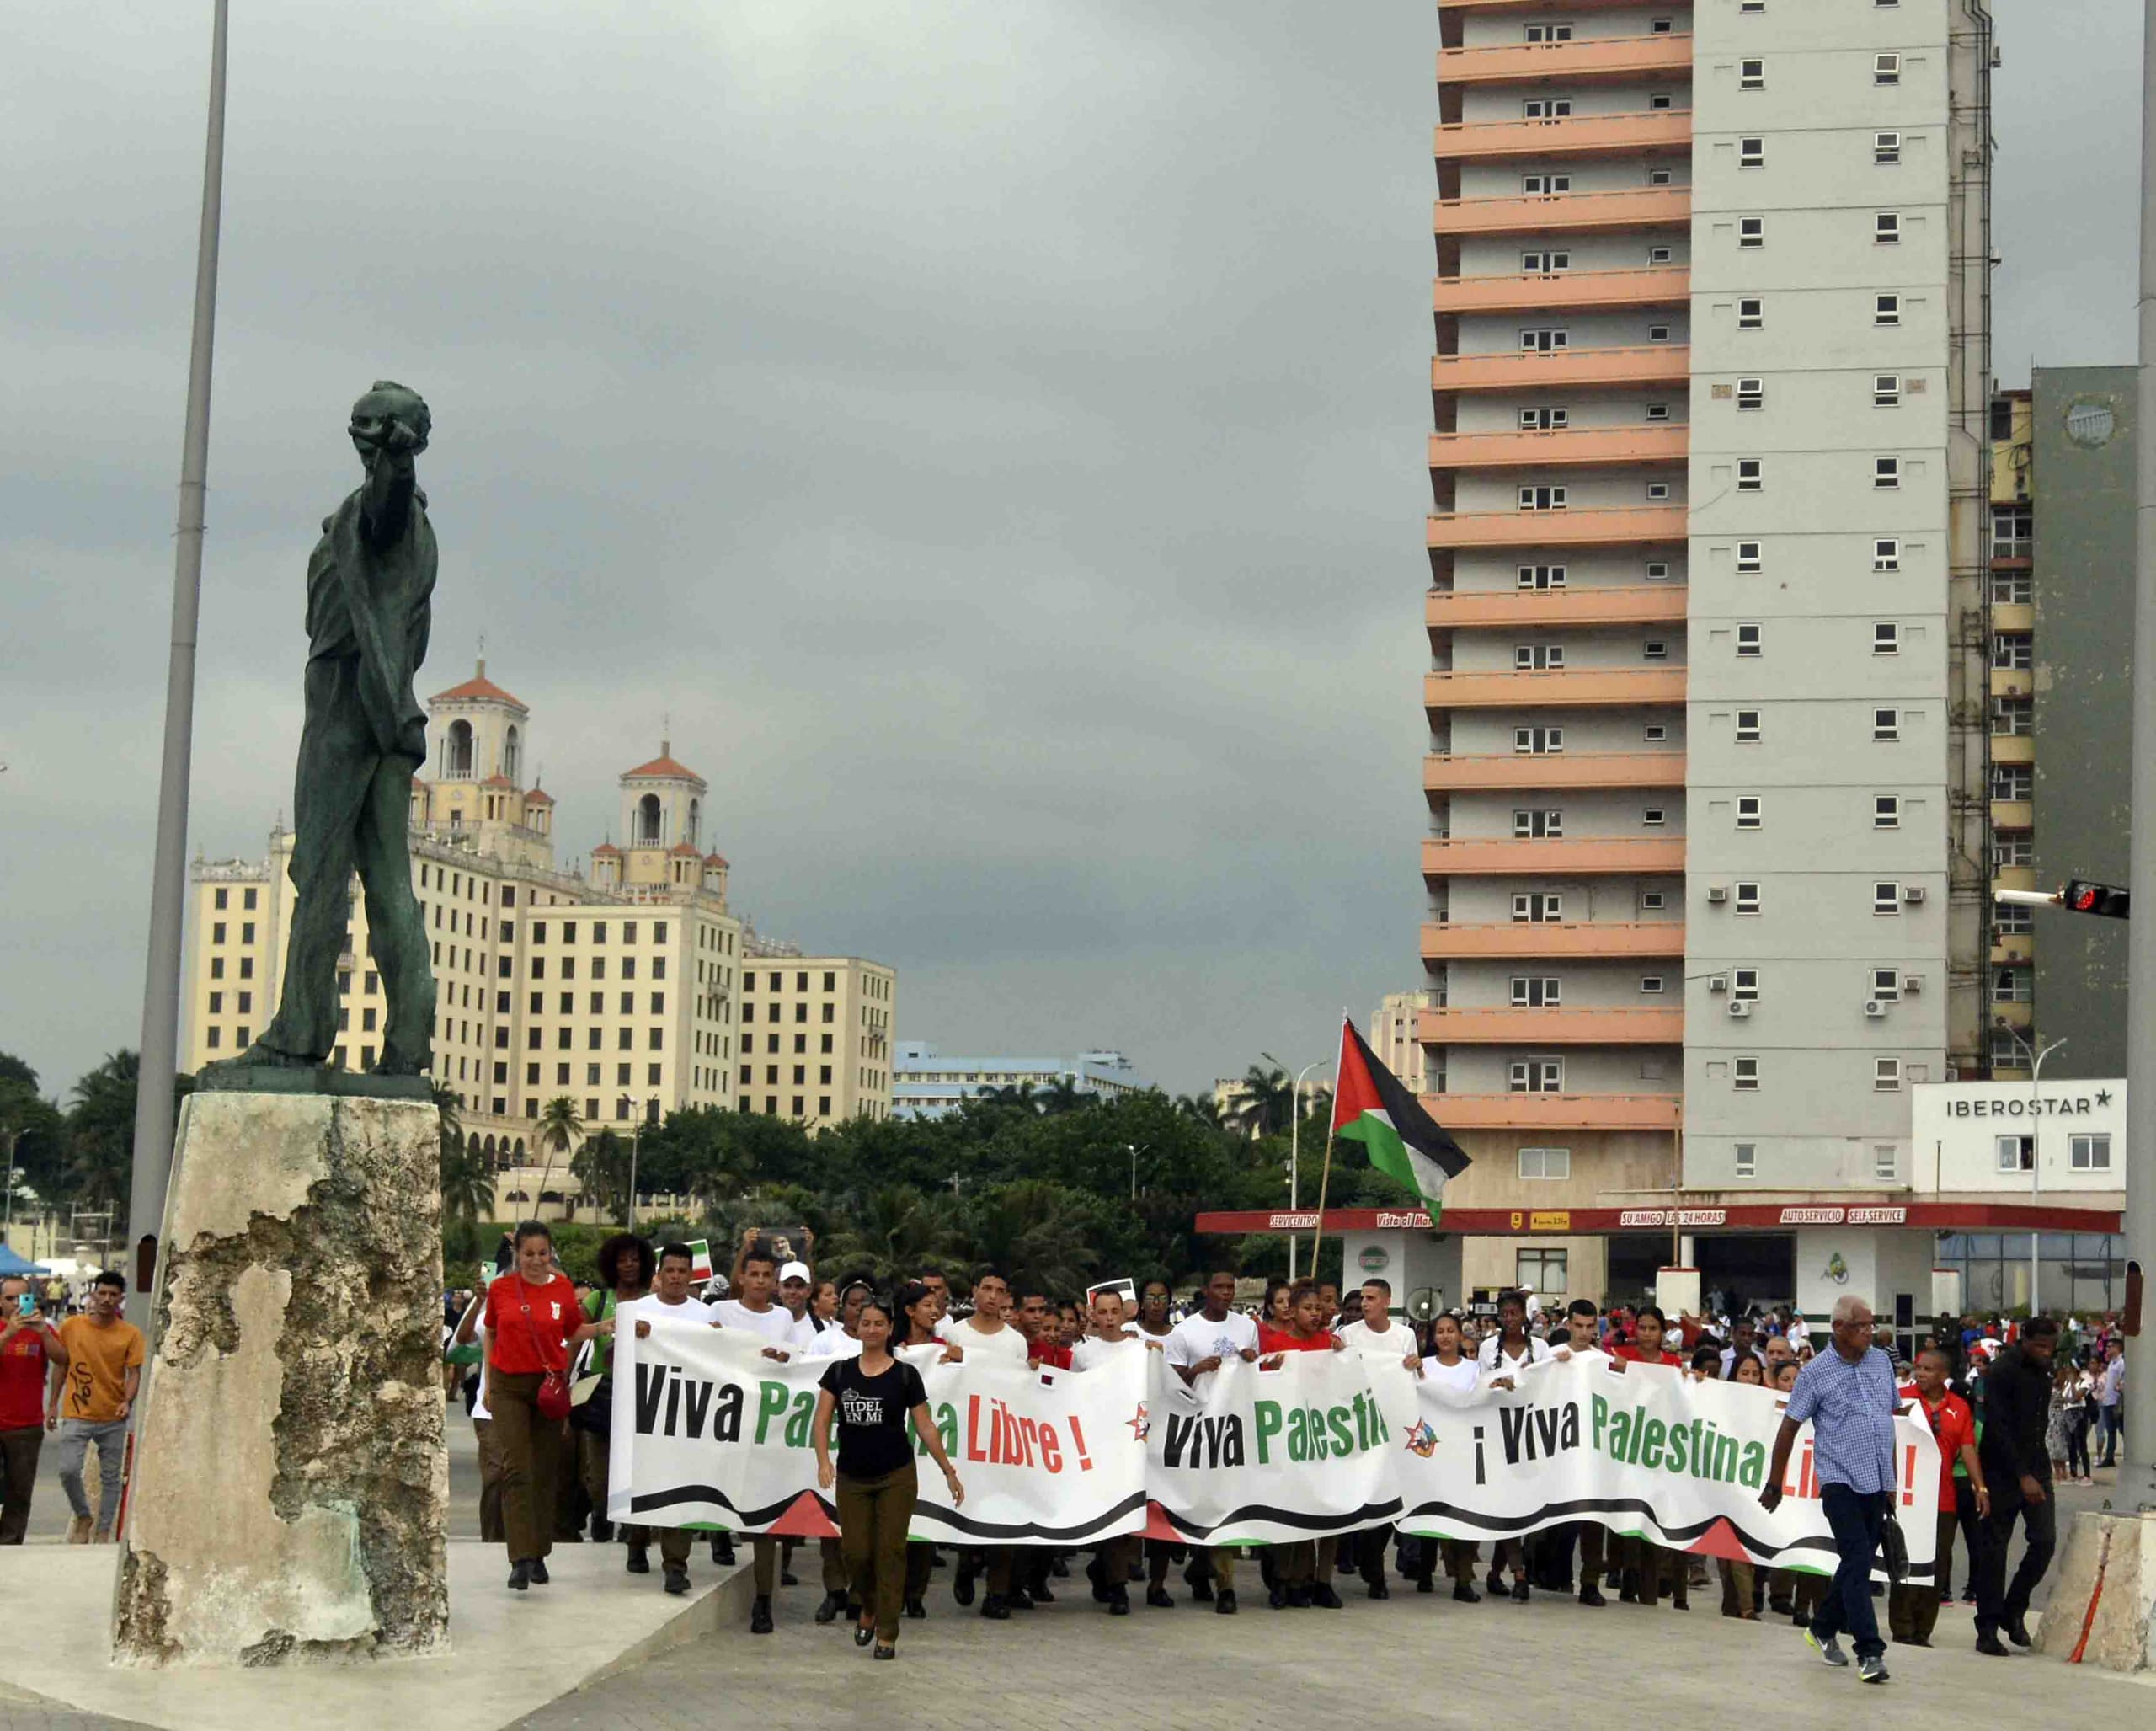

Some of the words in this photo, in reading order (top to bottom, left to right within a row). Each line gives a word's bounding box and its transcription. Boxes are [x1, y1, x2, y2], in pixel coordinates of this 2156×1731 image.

[1947, 1098, 2090, 1117] IBEROSTAR
[1270, 1215, 1318, 1226] SERVICENTRO
[1377, 1214, 1399, 1226] Vista
[1401, 1214, 1412, 1227] al
[1621, 1212, 1633, 1224] SU
[1636, 1212, 1663, 1224] AMIGO
[1684, 1211, 1693, 1224] 24
[1694, 1211, 1724, 1223] HORAS
[635, 1362, 744, 1442] Viva
[843, 1401, 883, 1412] FIDEL
[846, 1412, 862, 1422] EN
[1164, 1410, 1245, 1469] Viva
[1499, 1402, 1580, 1465] Viva
[1592, 1392, 1765, 1489] Palestina
